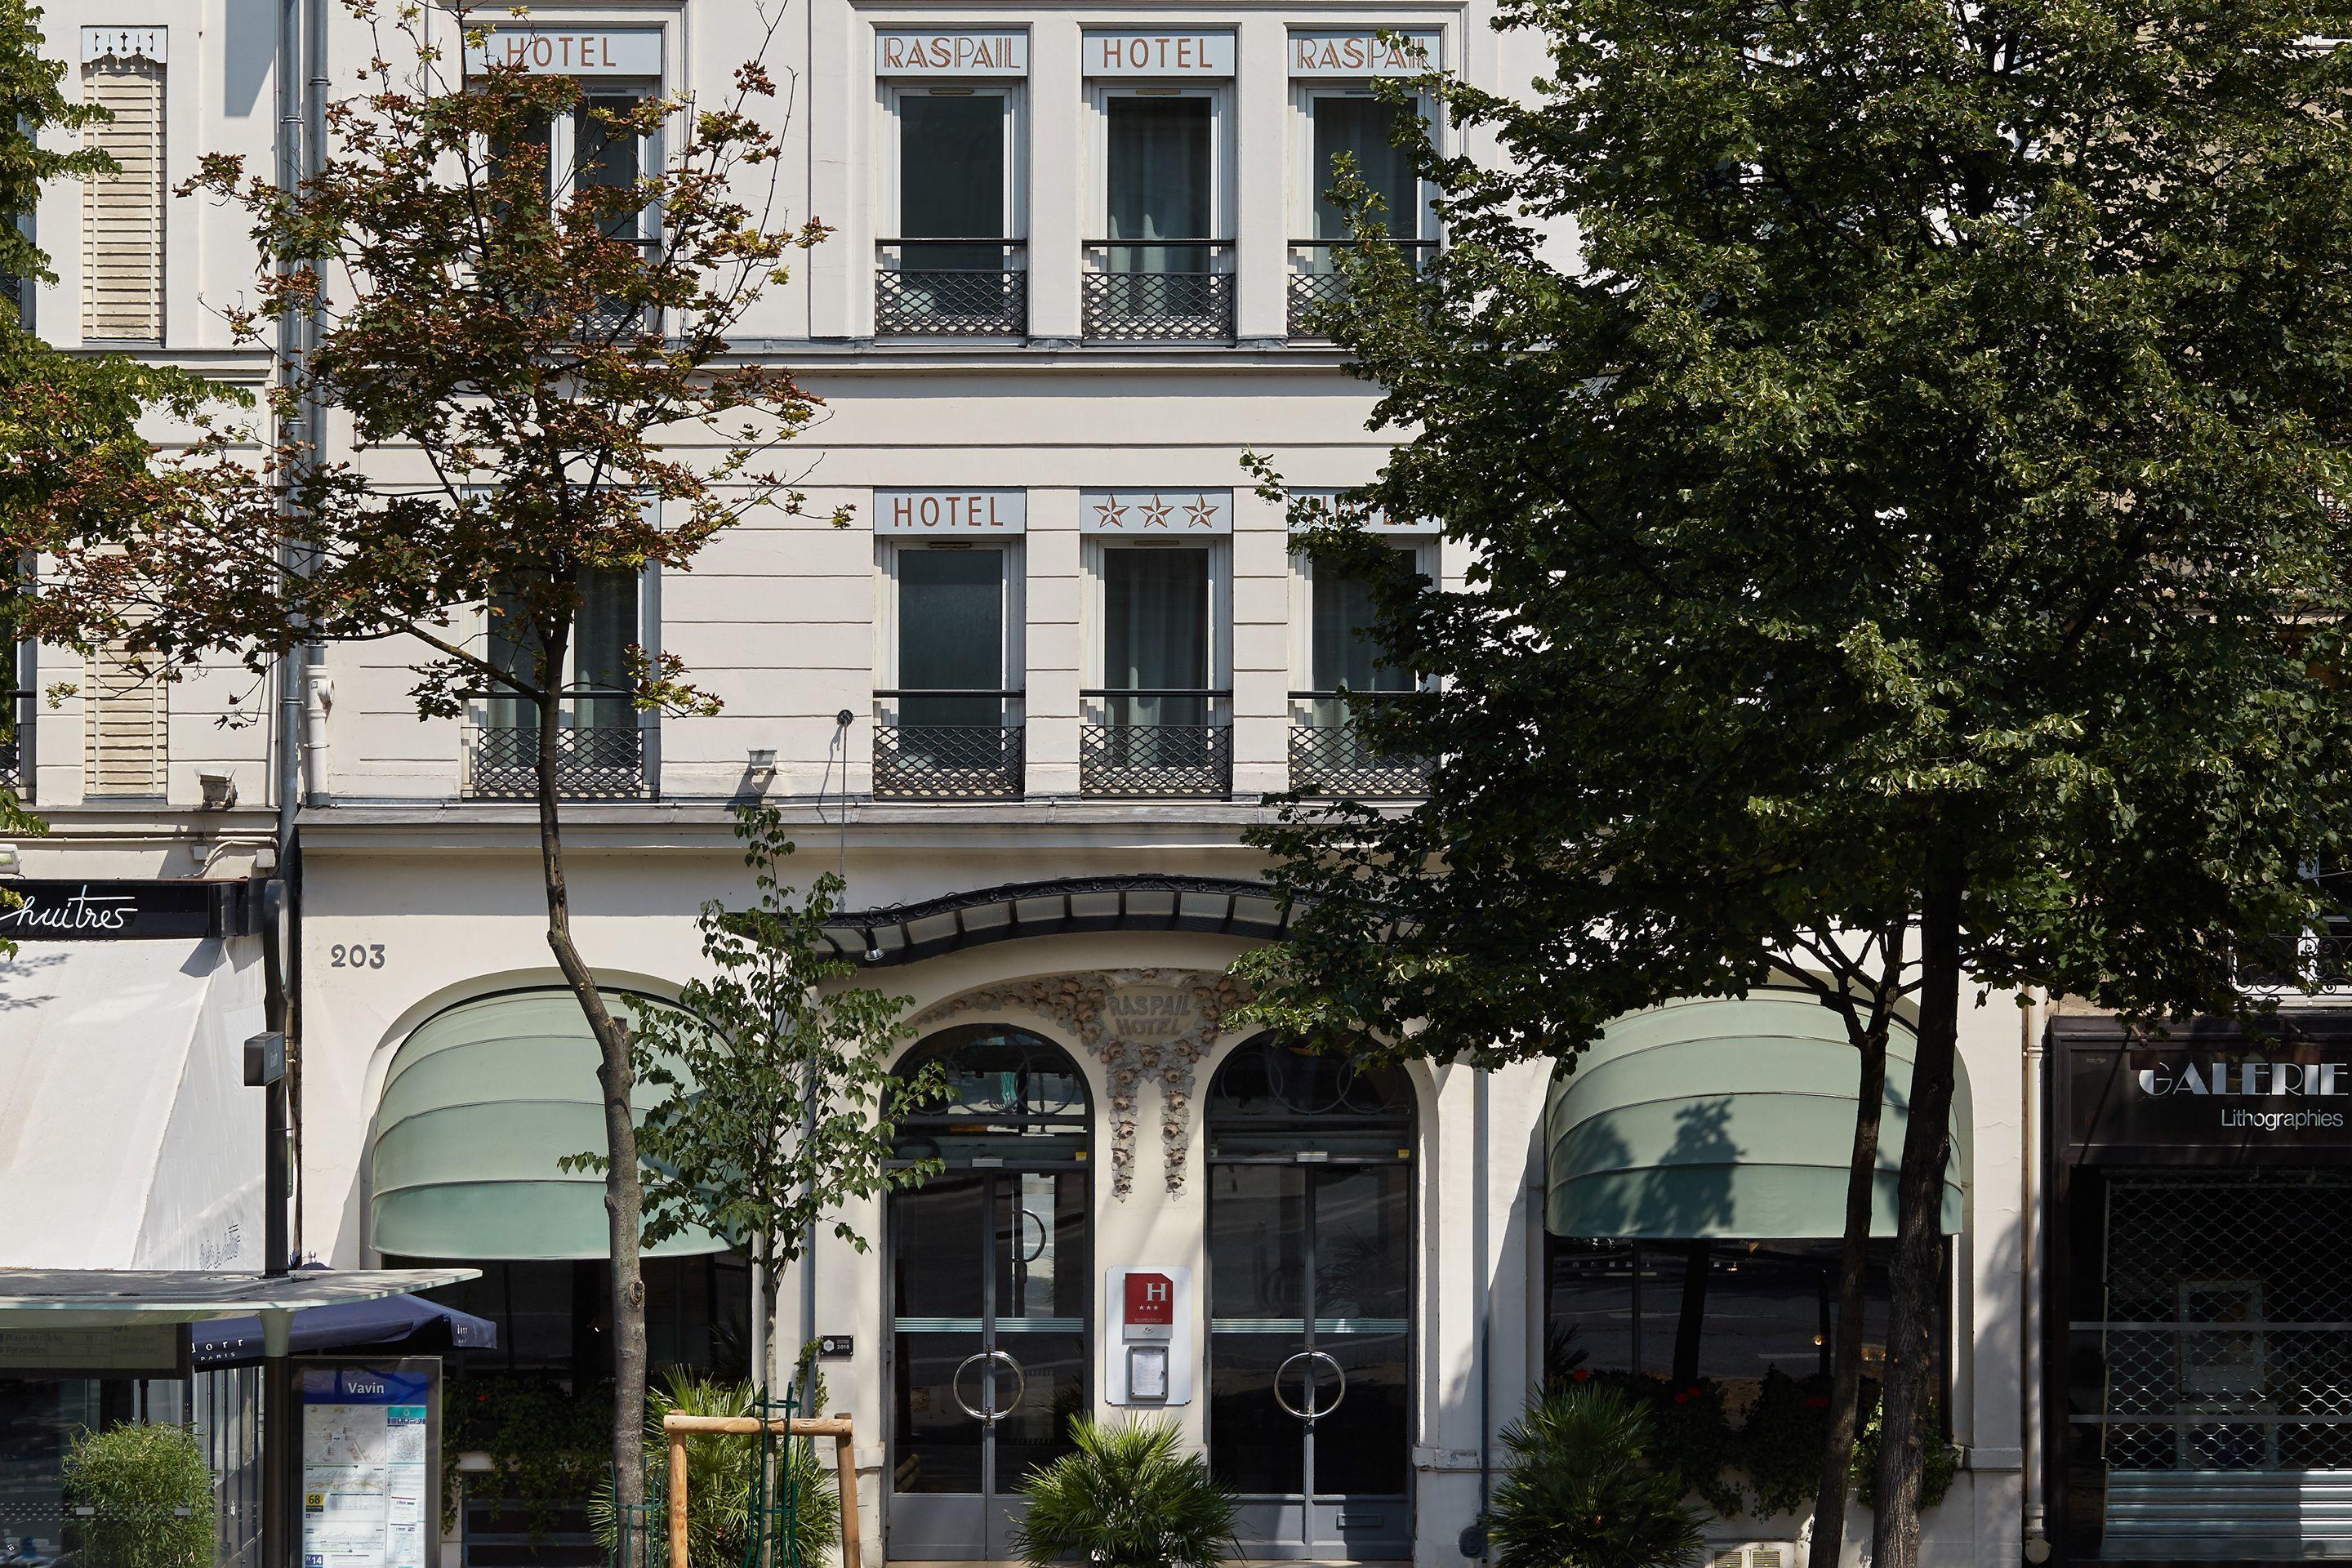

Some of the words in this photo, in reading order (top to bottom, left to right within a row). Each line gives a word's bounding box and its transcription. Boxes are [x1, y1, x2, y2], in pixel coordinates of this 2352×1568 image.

[507, 37, 616, 67] HOTEL
[886, 37, 1020, 69] RASPAIL
[1103, 38, 1213, 69] HOTEL
[893, 496, 1003, 527] HOTEL
[331, 944, 385, 969] 203
[1108, 996, 1191, 1015] RASPAIL
[1115, 1018, 1182, 1036] HOTEL
[2138, 1062, 2349, 1096] GALERIE
[2221, 1109, 2344, 1131] Lithographies
[1146, 1282, 1168, 1301] H
[200, 1352, 236, 1361] PARIS
[348, 1382, 385, 1394] Vavin
[308, 1495, 321, 1504] 68
